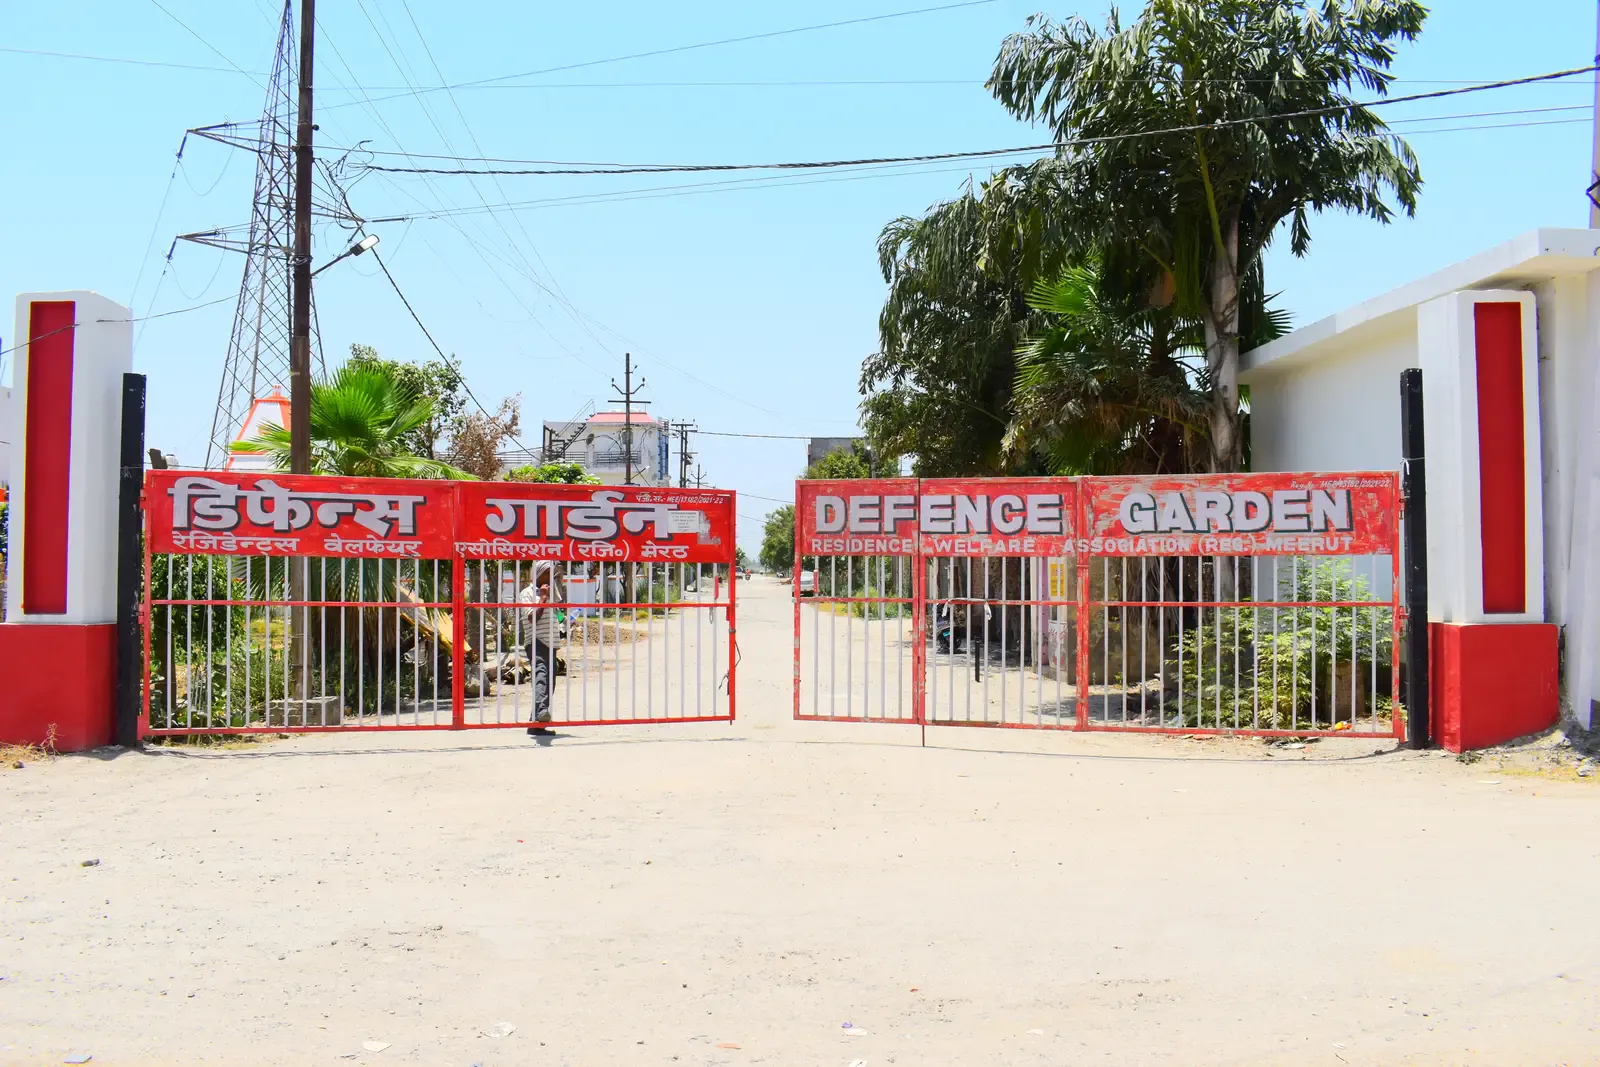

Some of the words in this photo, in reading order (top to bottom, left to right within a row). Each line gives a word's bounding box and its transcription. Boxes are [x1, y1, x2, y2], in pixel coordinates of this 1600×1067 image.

[167, 476, 426, 538] डिफेन्स
[485, 491, 680, 542] गार्डन
[815, 494, 1064, 535] DEFENCE
[1118, 489, 1354, 534] GARDEN
[324, 533, 422, 557] वेलफेयर
[454, 538, 563, 558] एसोसिएशन
[641, 540, 689, 559] मेरठ
[811, 537, 913, 553] RESIDENCE
[933, 538, 1036, 553] WELFARE
[1063, 537, 1192, 553] ASSOCIATION
